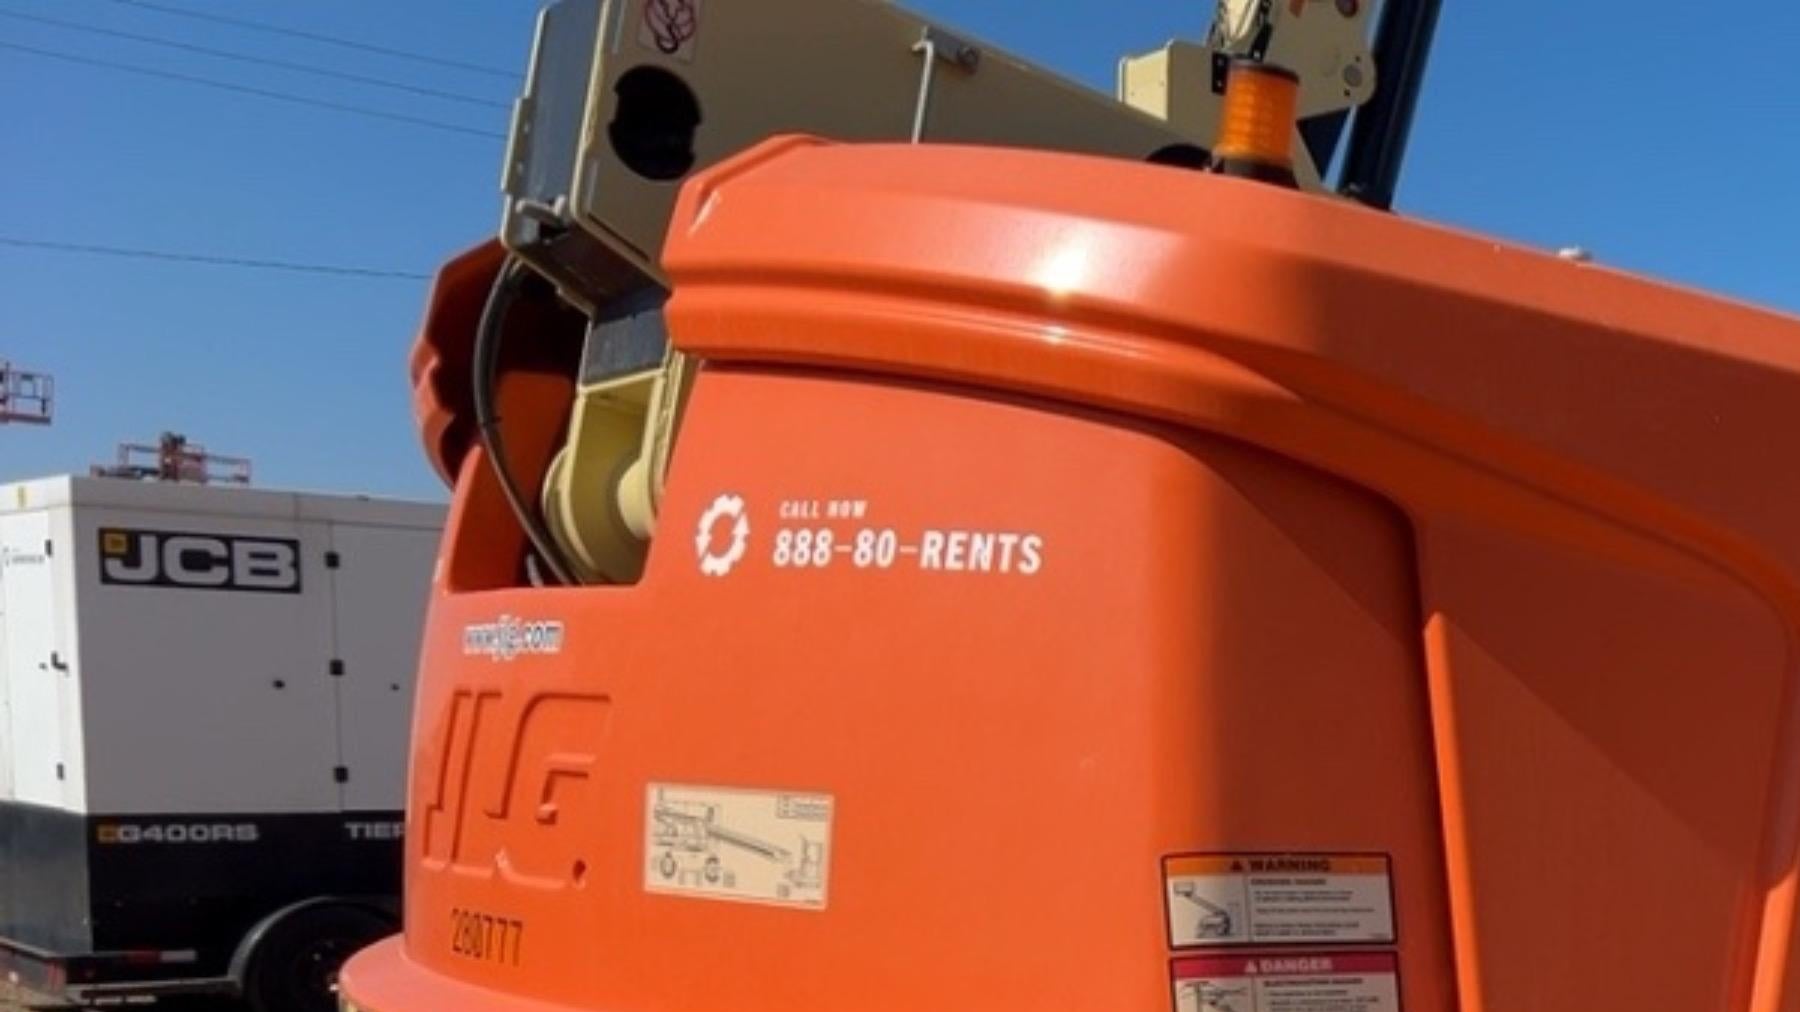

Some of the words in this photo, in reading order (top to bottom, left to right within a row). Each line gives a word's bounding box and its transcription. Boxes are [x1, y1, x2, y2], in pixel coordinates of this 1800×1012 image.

[779, 500, 819, 519] CALL
[827, 501, 867, 519] NOW
[104, 534, 297, 588] JCB
[773, 528, 1043, 575] 888-80-RENTS
[1250, 859, 1331, 873] WARNING
[1258, 957, 1333, 973] DANGER
